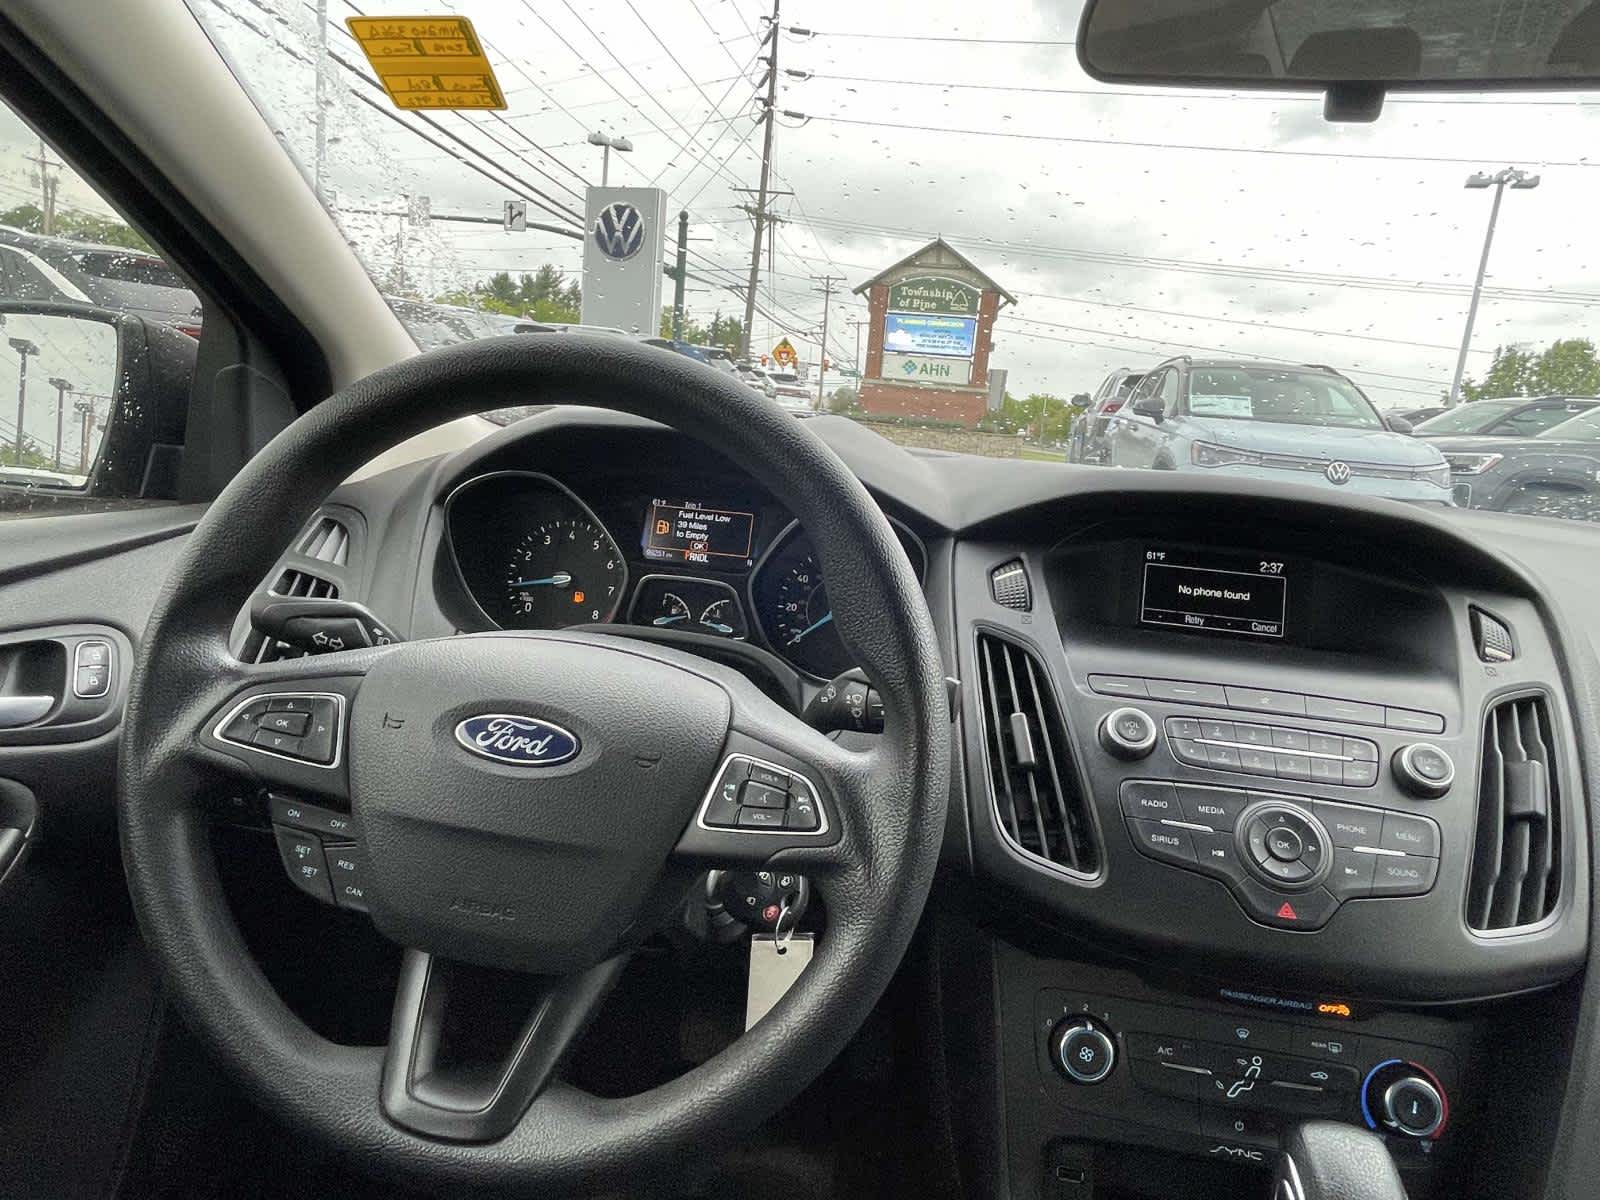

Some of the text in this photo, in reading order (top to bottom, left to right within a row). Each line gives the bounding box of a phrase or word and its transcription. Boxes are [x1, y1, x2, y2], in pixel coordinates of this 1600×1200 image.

[901, 286, 953, 300] Township
[900, 298, 937, 310] of Pine
[919, 363, 950, 377] AHN
[678, 511, 731, 522] Fuel Level Low
[677, 521, 708, 530] 39 Miles
[544, 536, 550, 545] 3
[569, 531, 575, 540] 4
[676, 530, 709, 542] to Empty
[593, 541, 600, 550] 5
[693, 542, 704, 550] OK
[525, 551, 532, 560] 2
[607, 560, 613, 569] 6
[1259, 561, 1284, 573] 2:37
[797, 574, 809, 583] 40
[608, 586, 615, 596] 7
[1178, 584, 1250, 600] No phone found
[525, 602, 532, 612] 0
[785, 602, 797, 612] 20
[592, 610, 598, 620] 8
[1184, 614, 1277, 633] Retry Cancel
[275, 719, 288, 728] OK
[475, 718, 554, 756] Ford
[1141, 798, 1225, 815] RADIO MEDIA
[287, 808, 347, 830] ON OFF
[1336, 823, 1421, 843] PHONE MENU
[1151, 834, 1180, 846] SIRIUS
[1276, 840, 1290, 850] OK
[295, 844, 312, 855] SET
[302, 865, 318, 876] SET
[338, 859, 355, 871] RES
[1387, 867, 1419, 879] SOUND
[345, 886, 363, 897] CAN
[1082, 1003, 1089, 1011] 2
[1104, 1013, 1109, 1021] 3
[1157, 1046, 1173, 1056] A/C
[1210, 1145, 1263, 1161] SYNC
